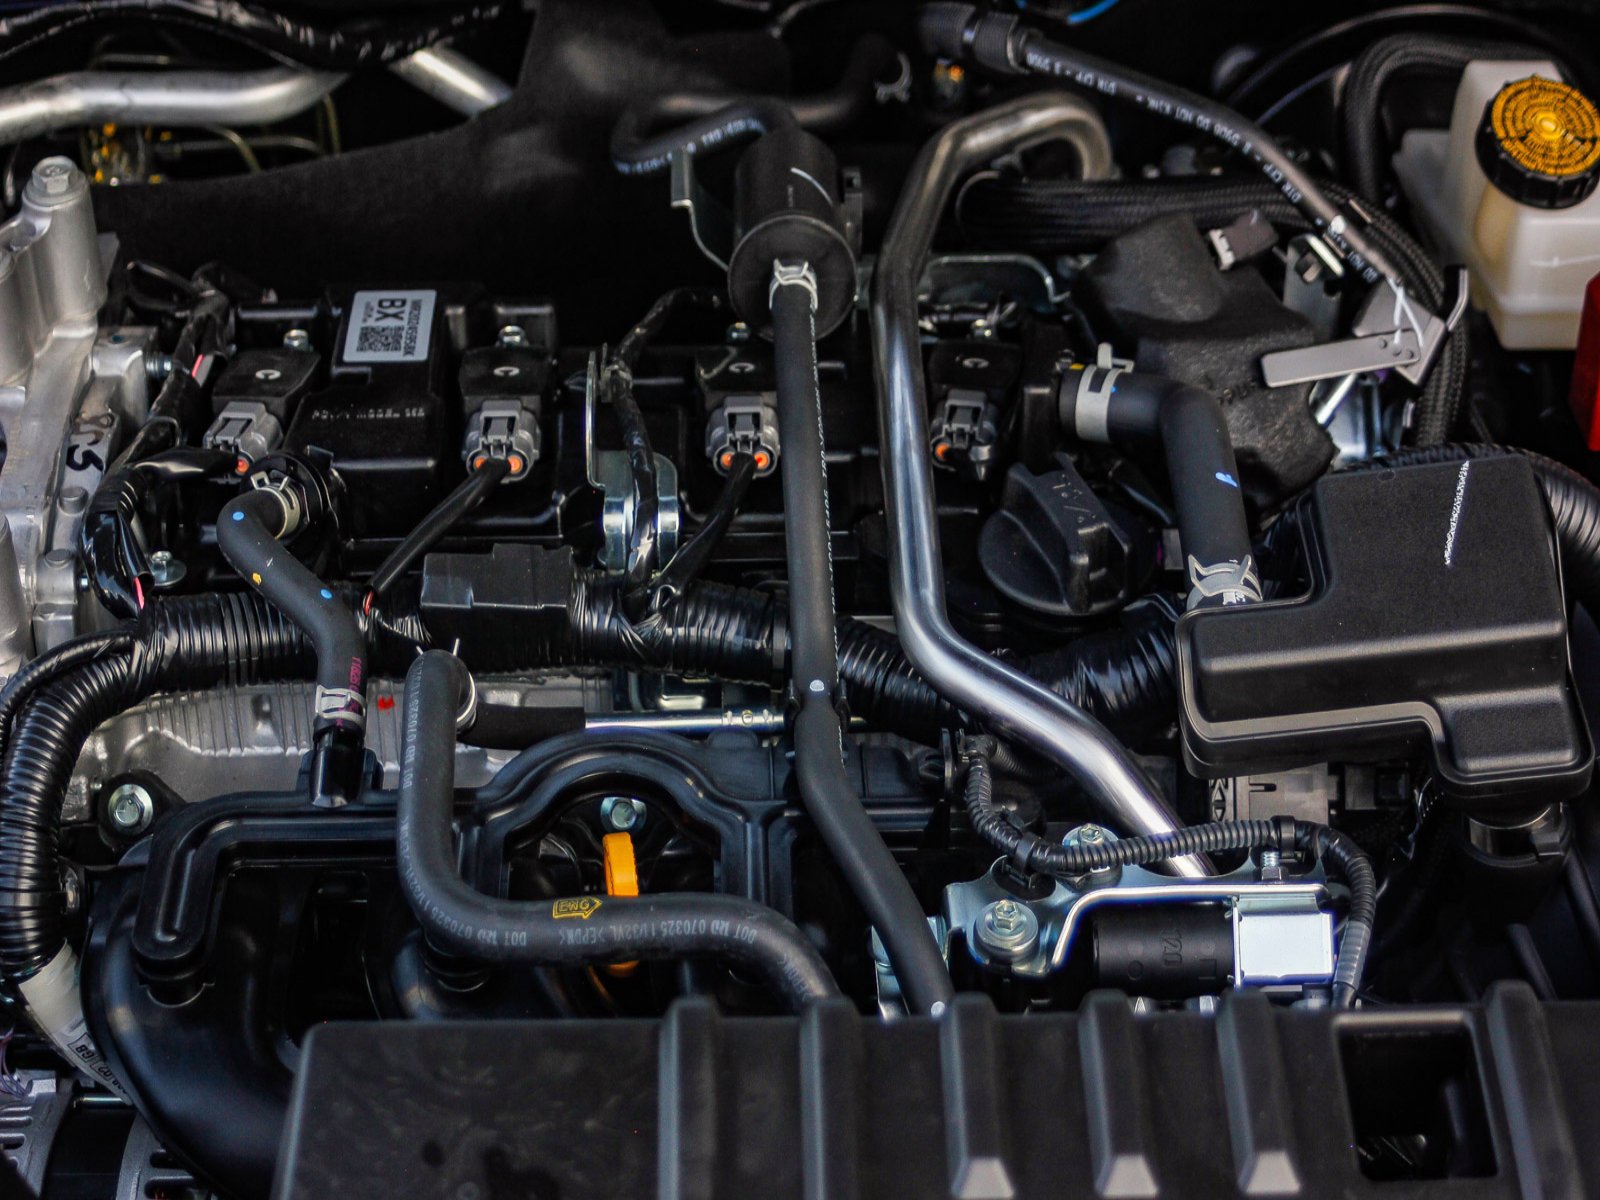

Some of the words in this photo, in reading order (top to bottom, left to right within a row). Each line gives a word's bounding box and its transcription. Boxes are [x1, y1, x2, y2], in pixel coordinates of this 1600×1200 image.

[375, 298, 407, 322] BX
[559, 899, 591, 913] ENG
[661, 918, 706, 938] 070325
[734, 924, 757, 945] DOT
[504, 931, 527, 947] DOT
[75, 1043, 96, 1060] GB
